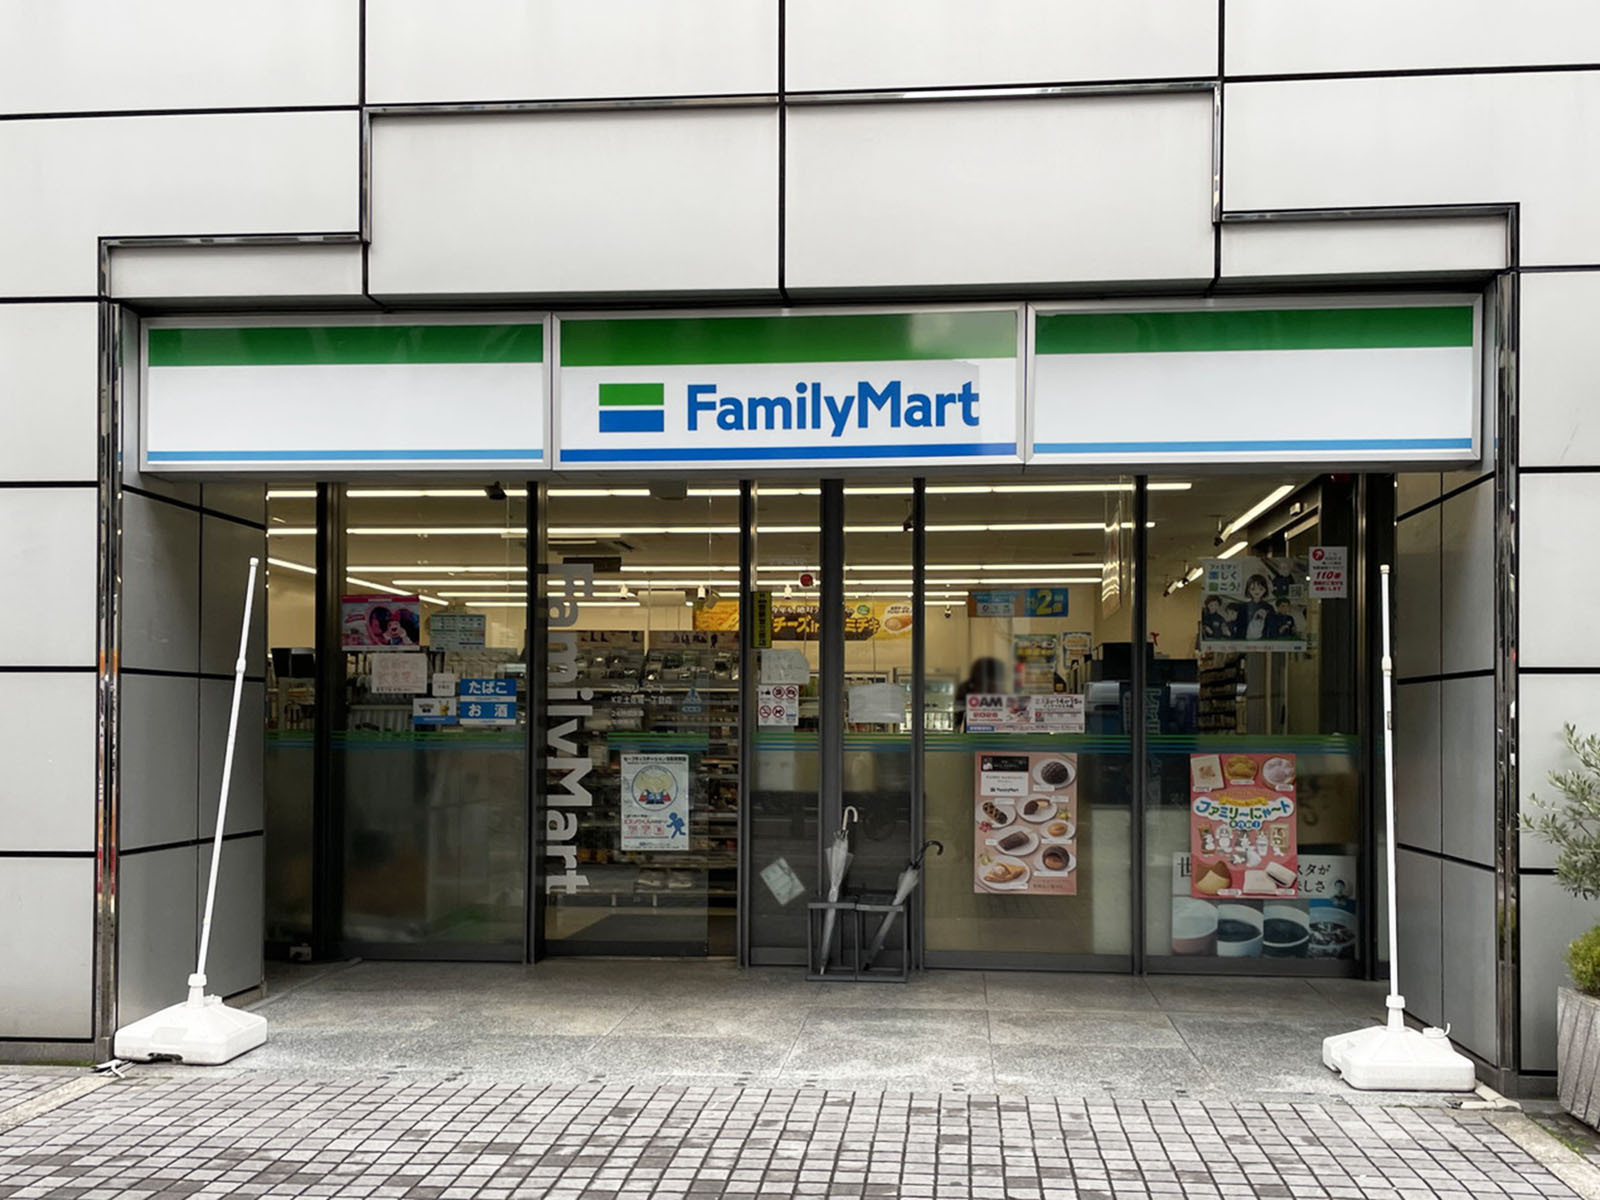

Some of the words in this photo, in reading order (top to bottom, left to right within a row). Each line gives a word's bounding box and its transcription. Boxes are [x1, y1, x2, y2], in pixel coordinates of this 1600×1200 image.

[687, 381, 980, 437] FamilyMart
[468, 680, 508, 694] たばこ
[968, 695, 1003, 707] OAM
[467, 703, 508, 717] お酒
